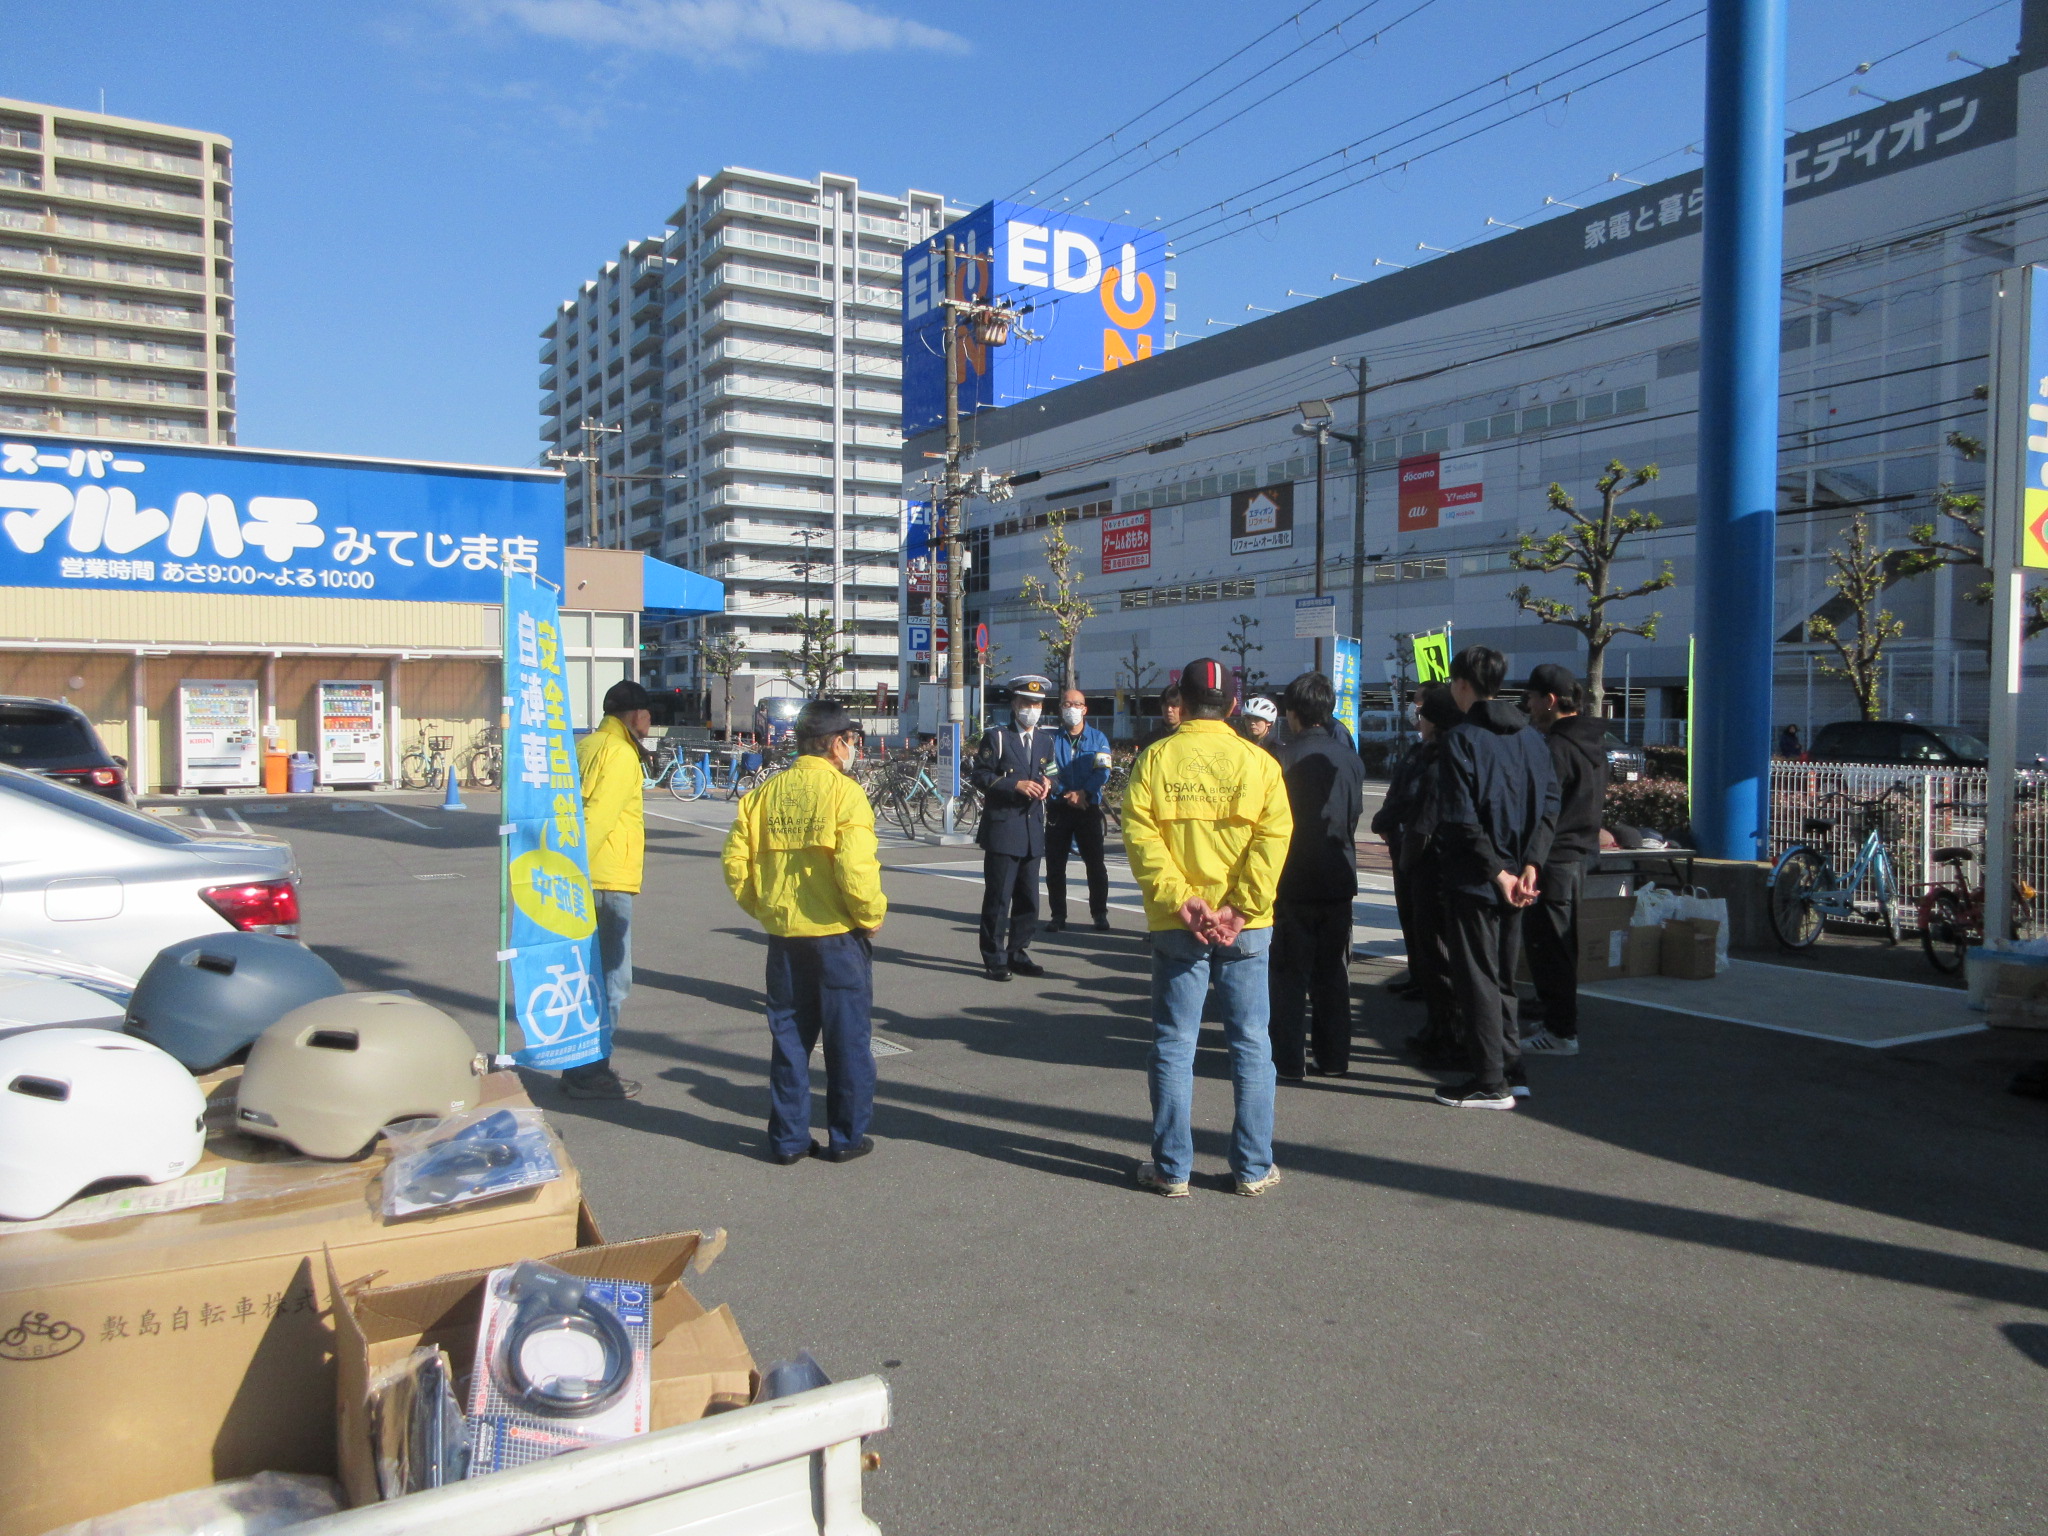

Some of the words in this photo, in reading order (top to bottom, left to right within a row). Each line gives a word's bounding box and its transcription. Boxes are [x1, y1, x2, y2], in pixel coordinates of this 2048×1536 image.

[1783, 97, 1980, 188] エディオン
[3, 443, 146, 478] スーパー
[1403, 470, 1435, 482] docomo
[1249, 507, 1274, 518] エディオン
[1408, 505, 1428, 518] au
[0, 479, 326, 562] マルハチ
[333, 527, 539, 573] みてじま店
[1248, 518, 1273, 527] リフォーム
[61, 557, 155, 581] 営業時間
[912, 628, 927, 649] P
[1164, 783, 1206, 794] OSAKA
[1164, 794, 1218, 803] COMMERCE
